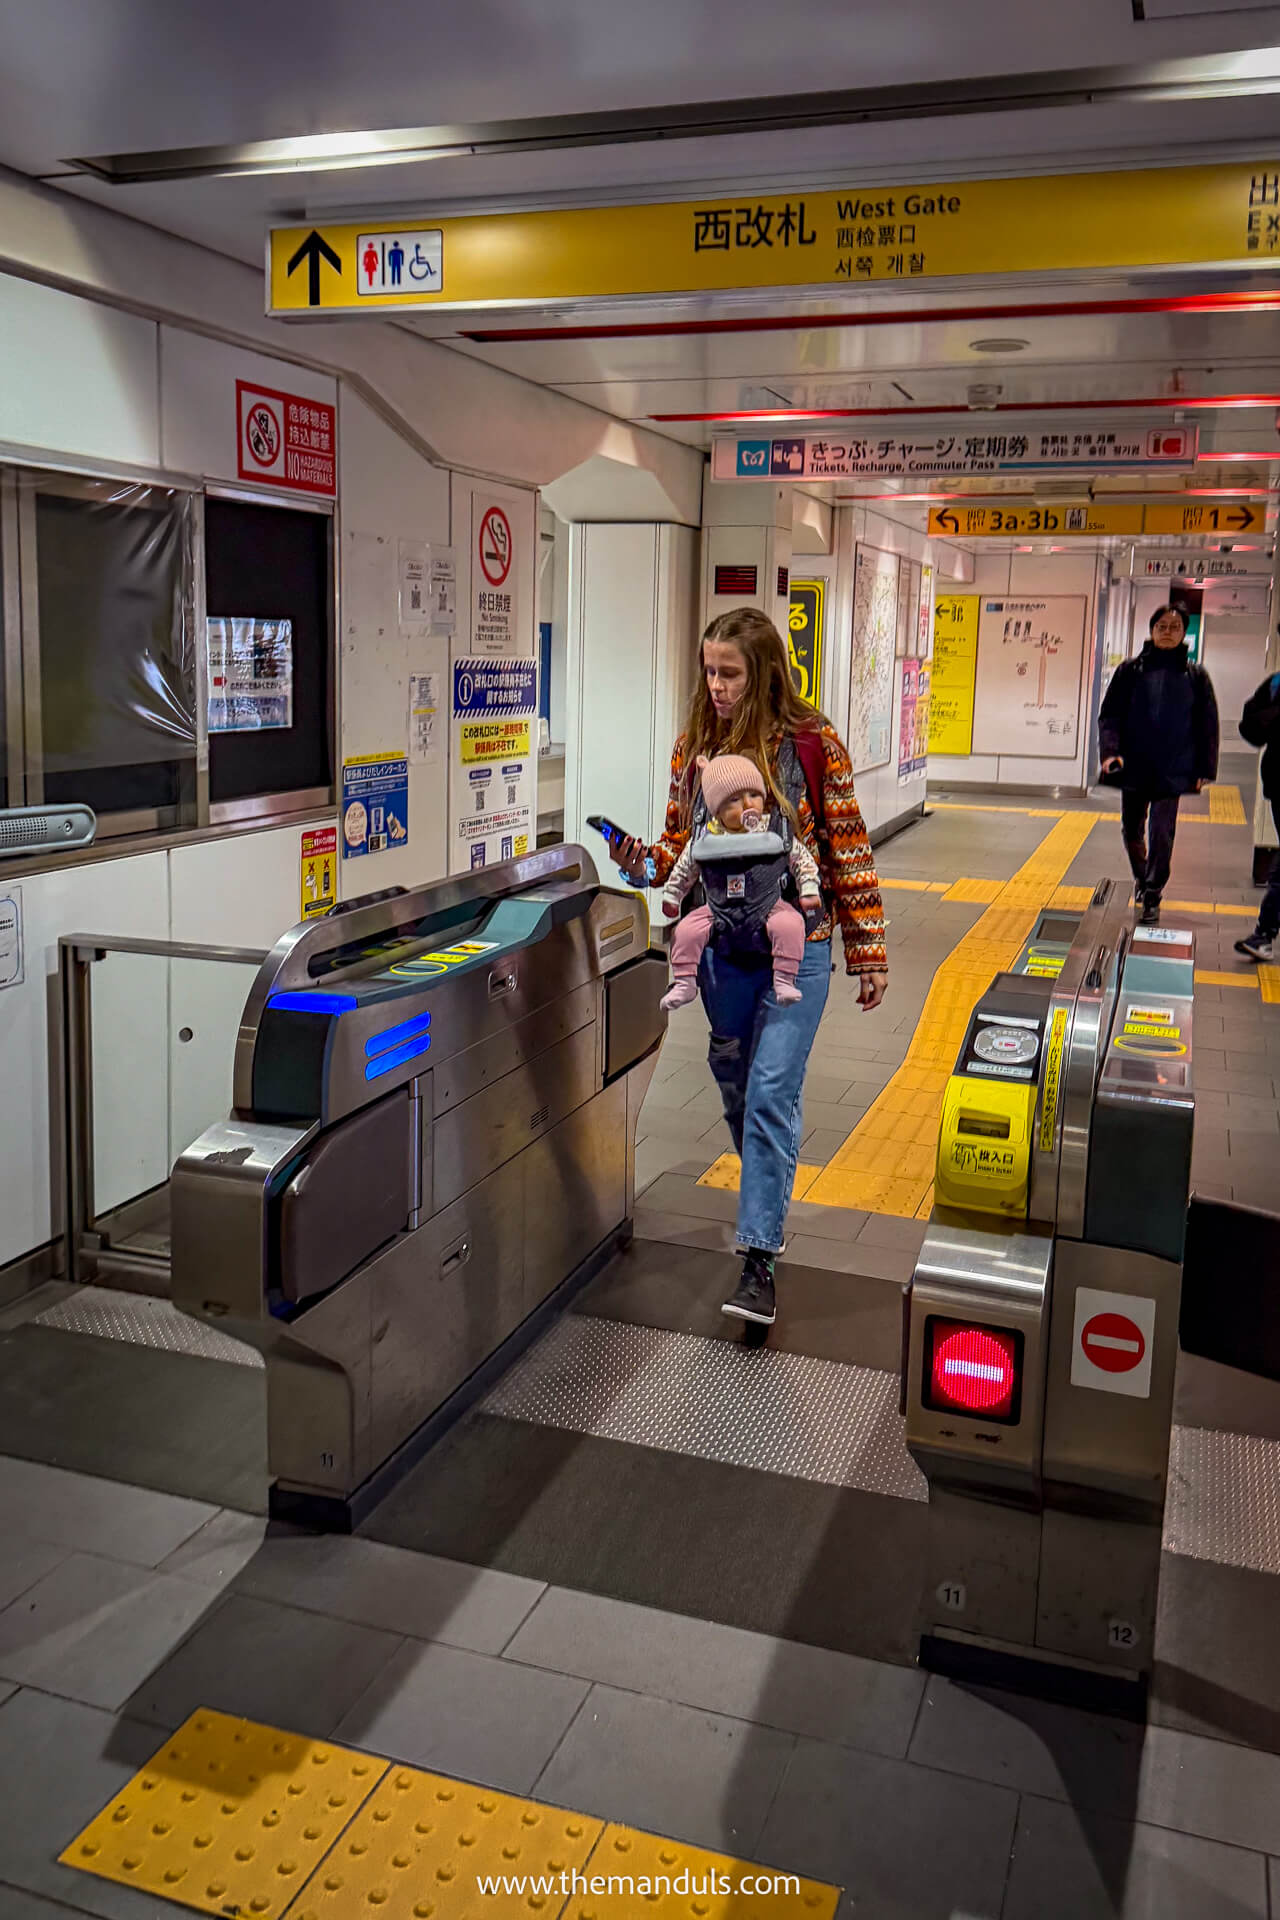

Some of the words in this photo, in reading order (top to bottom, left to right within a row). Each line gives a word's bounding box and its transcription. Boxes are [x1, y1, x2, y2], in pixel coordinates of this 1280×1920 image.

[837, 198, 895, 220] West
[904, 194, 961, 215] Gate
[693, 202, 817, 252] 西改札
[836, 224, 916, 248] 西检票口
[835, 255, 874, 277] 서쪽
[887, 252, 926, 274] 개찰
[288, 404, 330, 431] 危険物品
[287, 451, 300, 480] NO
[300, 455, 333, 472] HAZARDOUS
[809, 462, 849, 474] Tickets,
[852, 461, 905, 473] Recharge,
[908, 459, 967, 471] Commuter
[970, 459, 995, 470] Pass
[300, 468, 333, 486] MATERIALS
[1209, 508, 1219, 529] 1
[479, 592, 512, 612] 終日禁煙
[320, 1453, 334, 1468] 11
[943, 1587, 961, 1604] 11
[1112, 1626, 1133, 1643] 12
